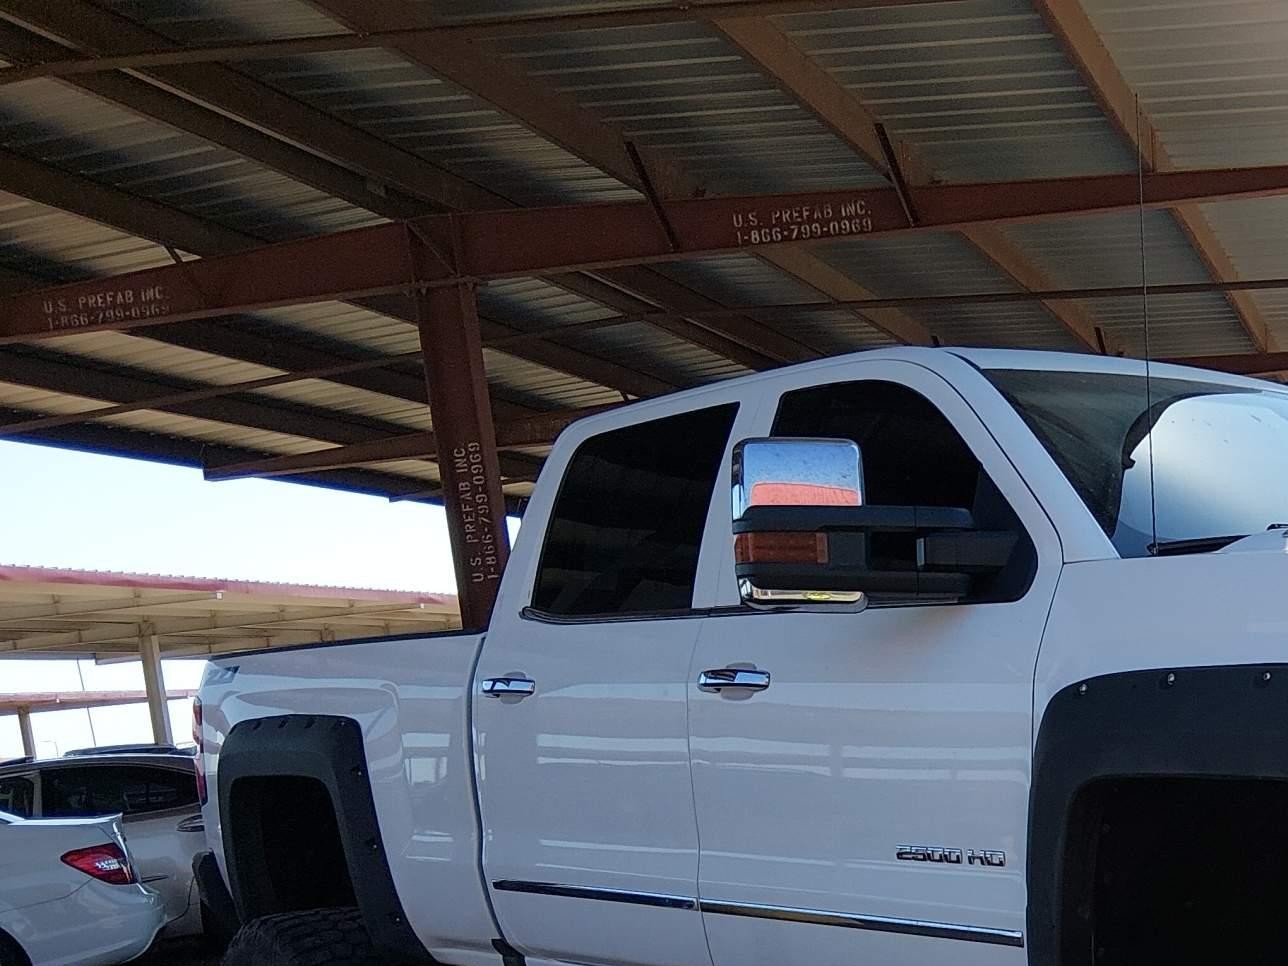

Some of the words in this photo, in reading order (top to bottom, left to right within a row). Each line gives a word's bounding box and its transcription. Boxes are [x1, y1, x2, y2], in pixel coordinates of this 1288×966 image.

[733, 213, 764, 228] U.S.
[772, 204, 833, 225] PREFAB
[841, 200, 872, 217] INC.
[737, 217, 873, 245] 1-866-799-0969
[78, 289, 134, 310] PREFAB
[458, 481, 480, 543] PREFAB
[468, 442, 499, 580] 1-866-799-0969
[470, 552, 485, 583] U.S.
[896, 844, 963, 864] 2500
[968, 849, 1006, 867] HD
